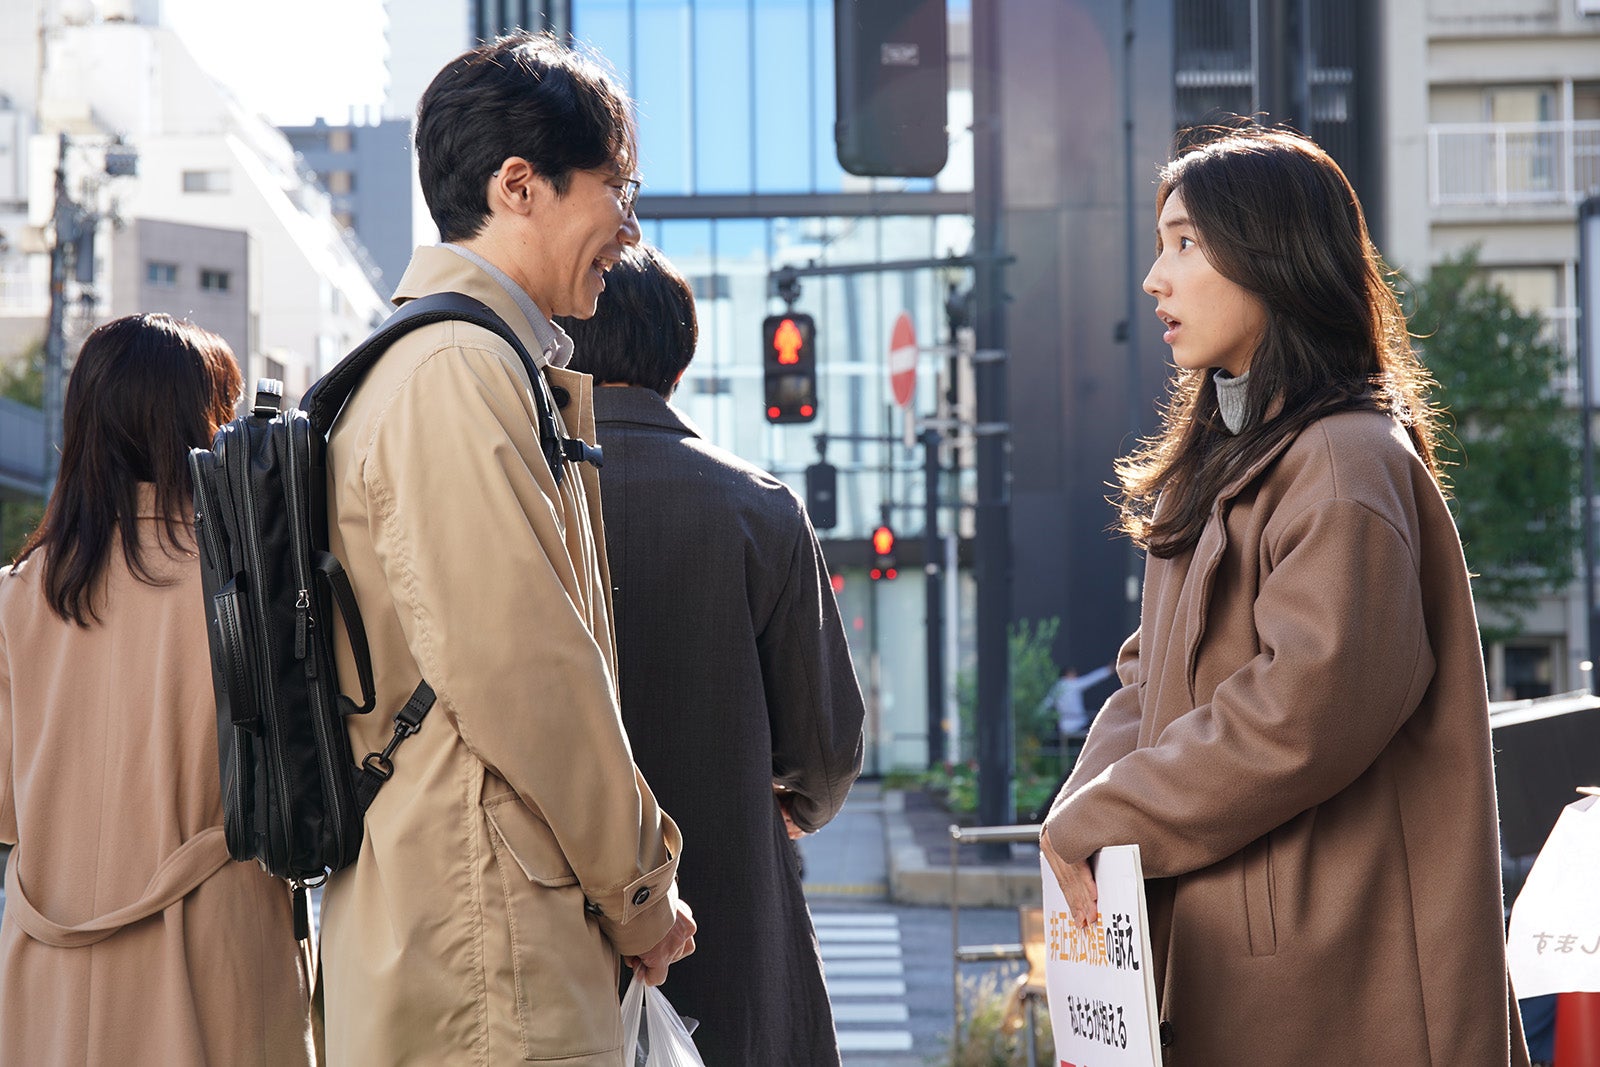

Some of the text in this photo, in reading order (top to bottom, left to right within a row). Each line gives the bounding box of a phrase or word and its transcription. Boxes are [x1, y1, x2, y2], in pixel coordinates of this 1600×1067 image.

[1067, 995, 1127, 1049] 私たちが抱える
